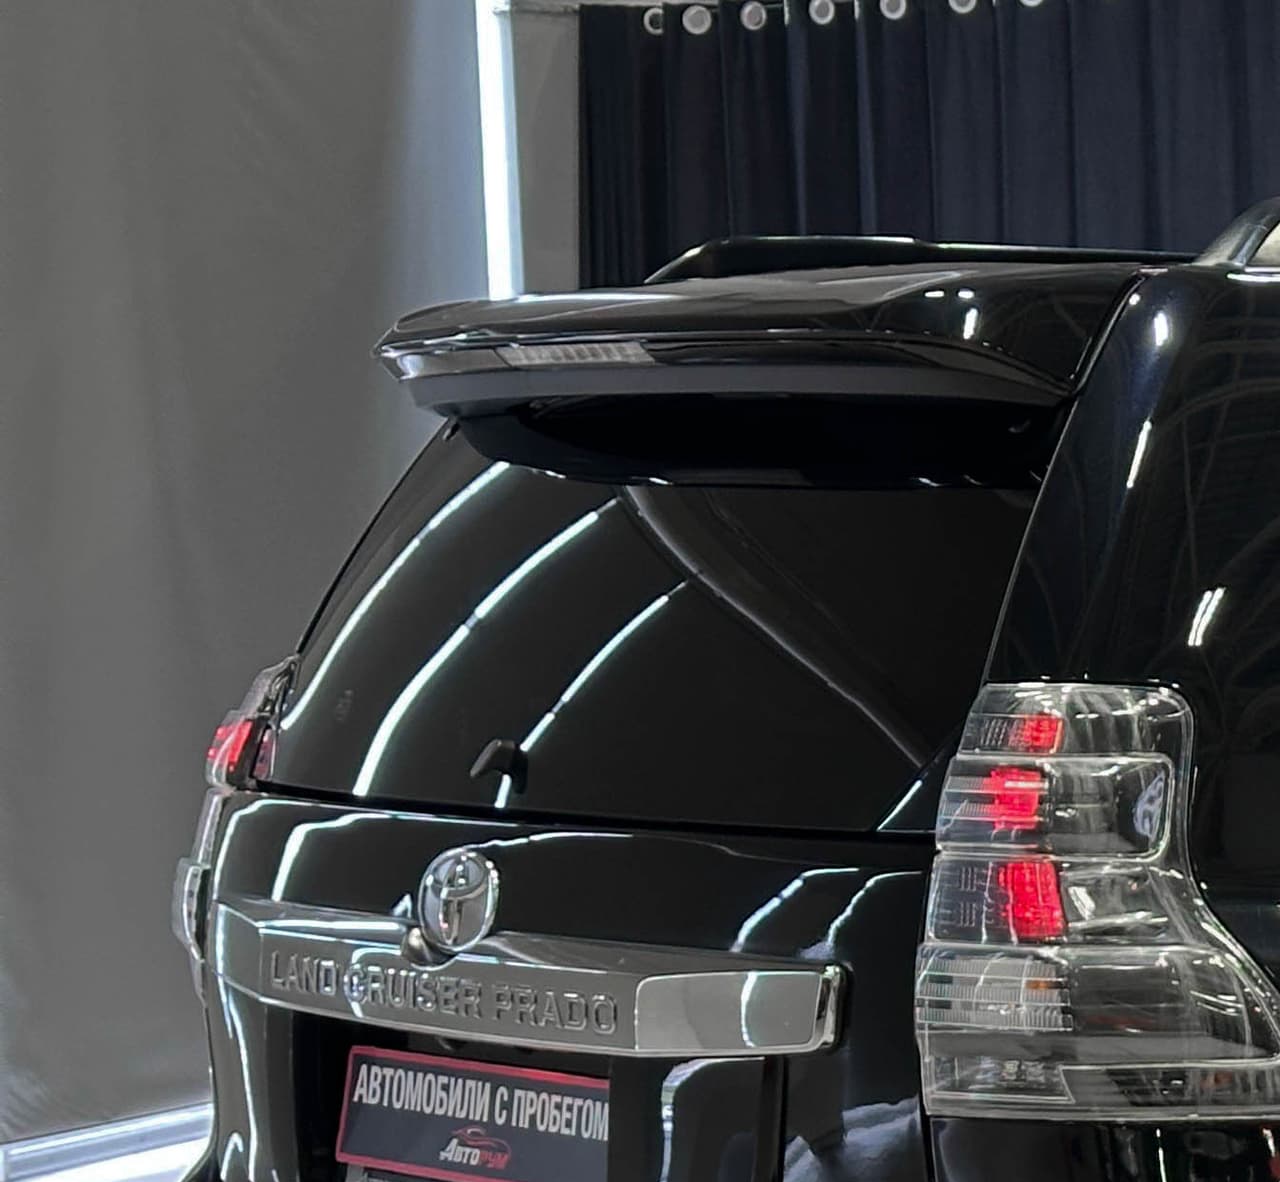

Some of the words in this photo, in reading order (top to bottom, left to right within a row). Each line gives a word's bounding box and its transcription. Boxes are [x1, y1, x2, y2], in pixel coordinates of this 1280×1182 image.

[271, 950, 338, 996] LAND
[343, 962, 483, 1020] CRUISER
[491, 982, 618, 1036] PRADO
[352, 1063, 491, 1123] АВТОМОБИЛИ
[494, 1085, 510, 1126] С
[511, 1088, 610, 1142] ПРОБЕГОМ
